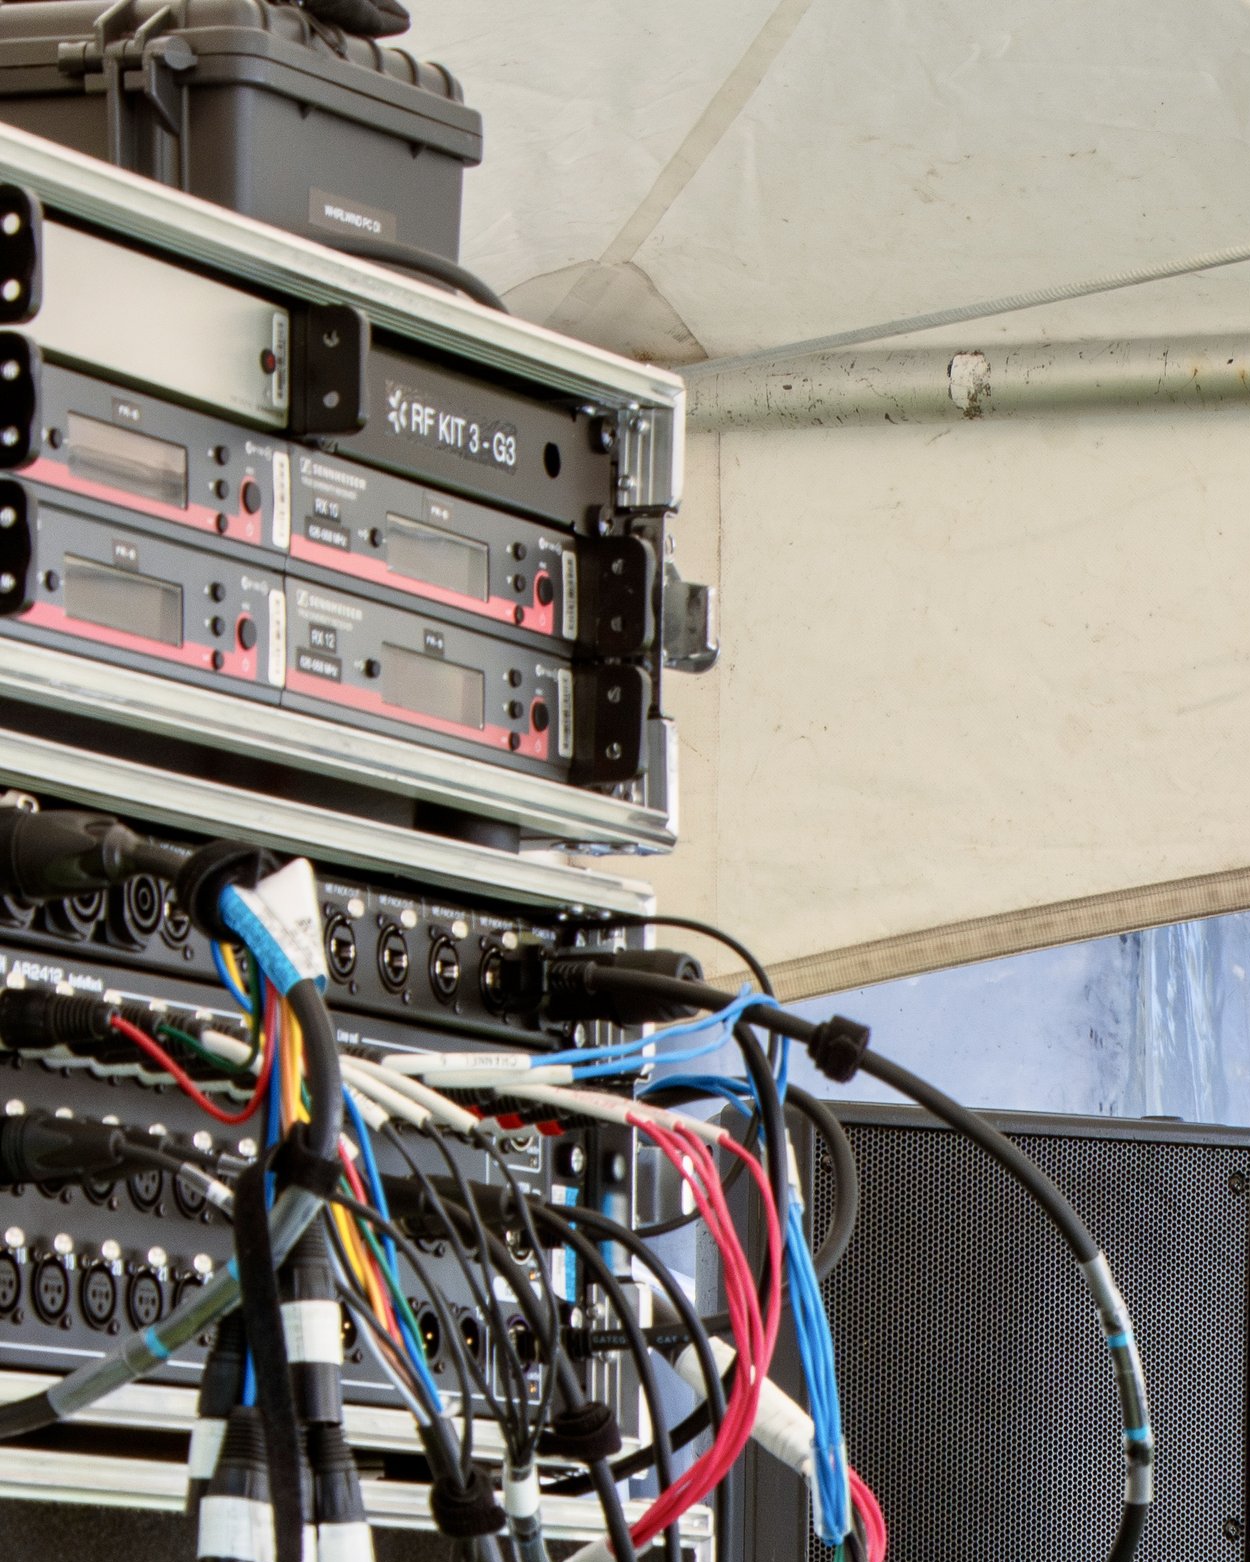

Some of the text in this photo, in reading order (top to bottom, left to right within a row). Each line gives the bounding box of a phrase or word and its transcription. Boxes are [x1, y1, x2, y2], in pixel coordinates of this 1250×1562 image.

[412, 402, 436, 436] RF
[438, 411, 467, 448] KIT
[469, 423, 480, 454] 3
[493, 431, 516, 466] G3
[311, 628, 335, 649] RX 12
